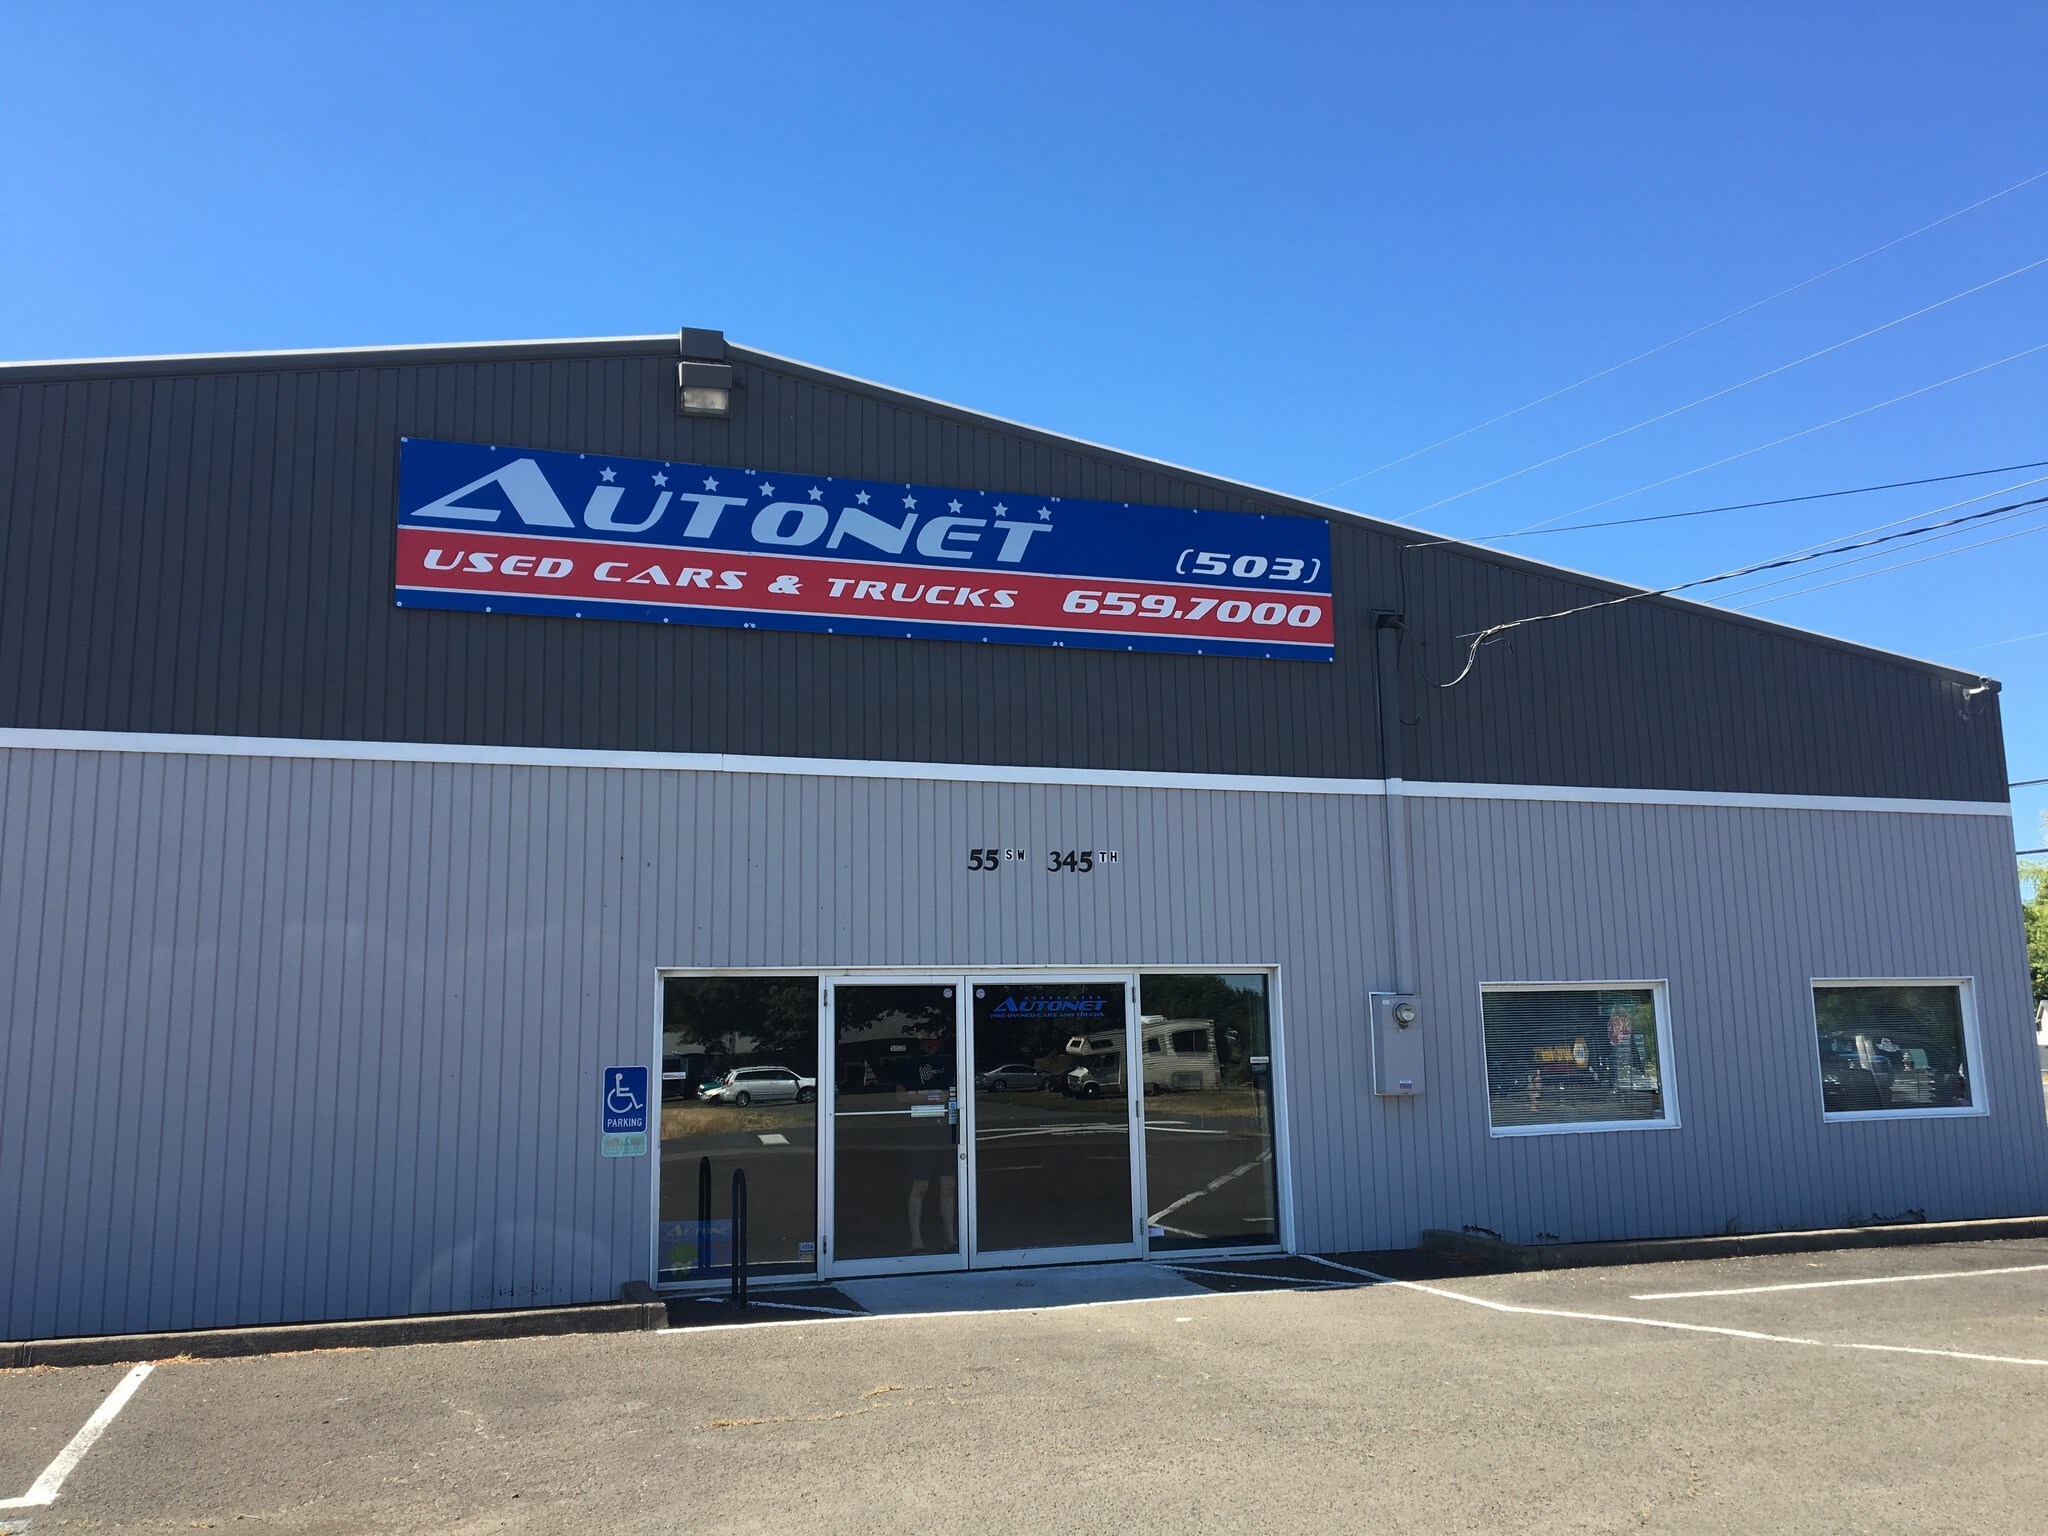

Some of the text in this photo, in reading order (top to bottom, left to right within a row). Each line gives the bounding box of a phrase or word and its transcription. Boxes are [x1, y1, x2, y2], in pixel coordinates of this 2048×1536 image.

[410, 458, 1054, 563] AUTONET
[423, 548, 1019, 609] USED CARS & TRUCKS
[1175, 549, 1321, 584] (503)
[1062, 590, 1323, 628] 659.7000
[967, 848, 1000, 872] 55
[1047, 850, 1093, 873] 345
[1098, 851, 1119, 864] TH
[993, 997, 1107, 1012] AUTONET
[607, 1117, 643, 1128] PARKING
